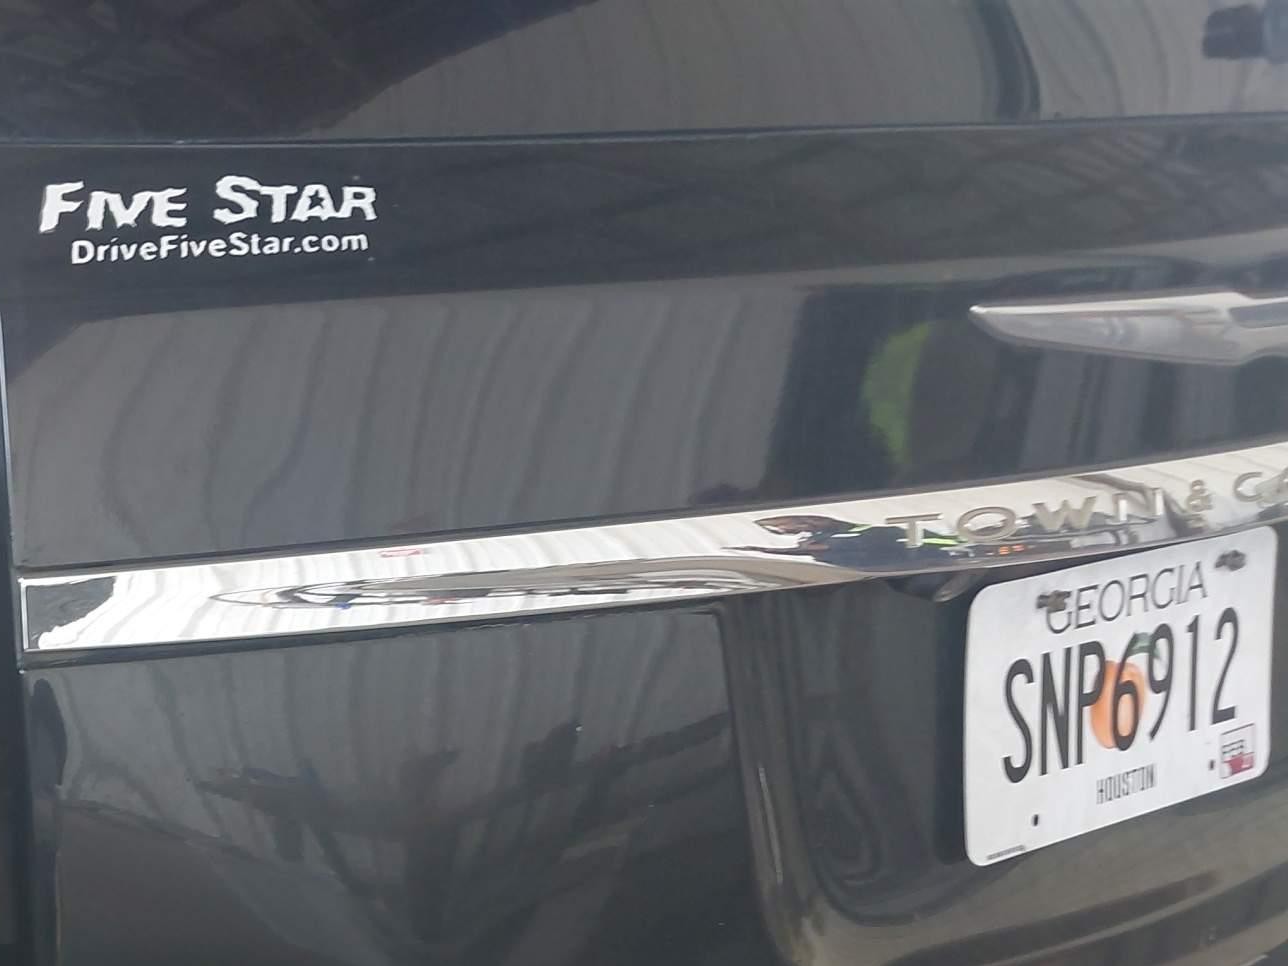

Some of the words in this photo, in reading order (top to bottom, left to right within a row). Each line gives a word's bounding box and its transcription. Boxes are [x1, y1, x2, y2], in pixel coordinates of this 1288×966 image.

[71, 232, 369, 265] DriveFiveStar.com
[886, 487, 1164, 549] TOWN
[1187, 479, 1213, 513] &
[1044, 560, 1208, 635] GEORGIA
[1002, 607, 1239, 783] SNP6912
[1096, 763, 1156, 804] HOUSTON
